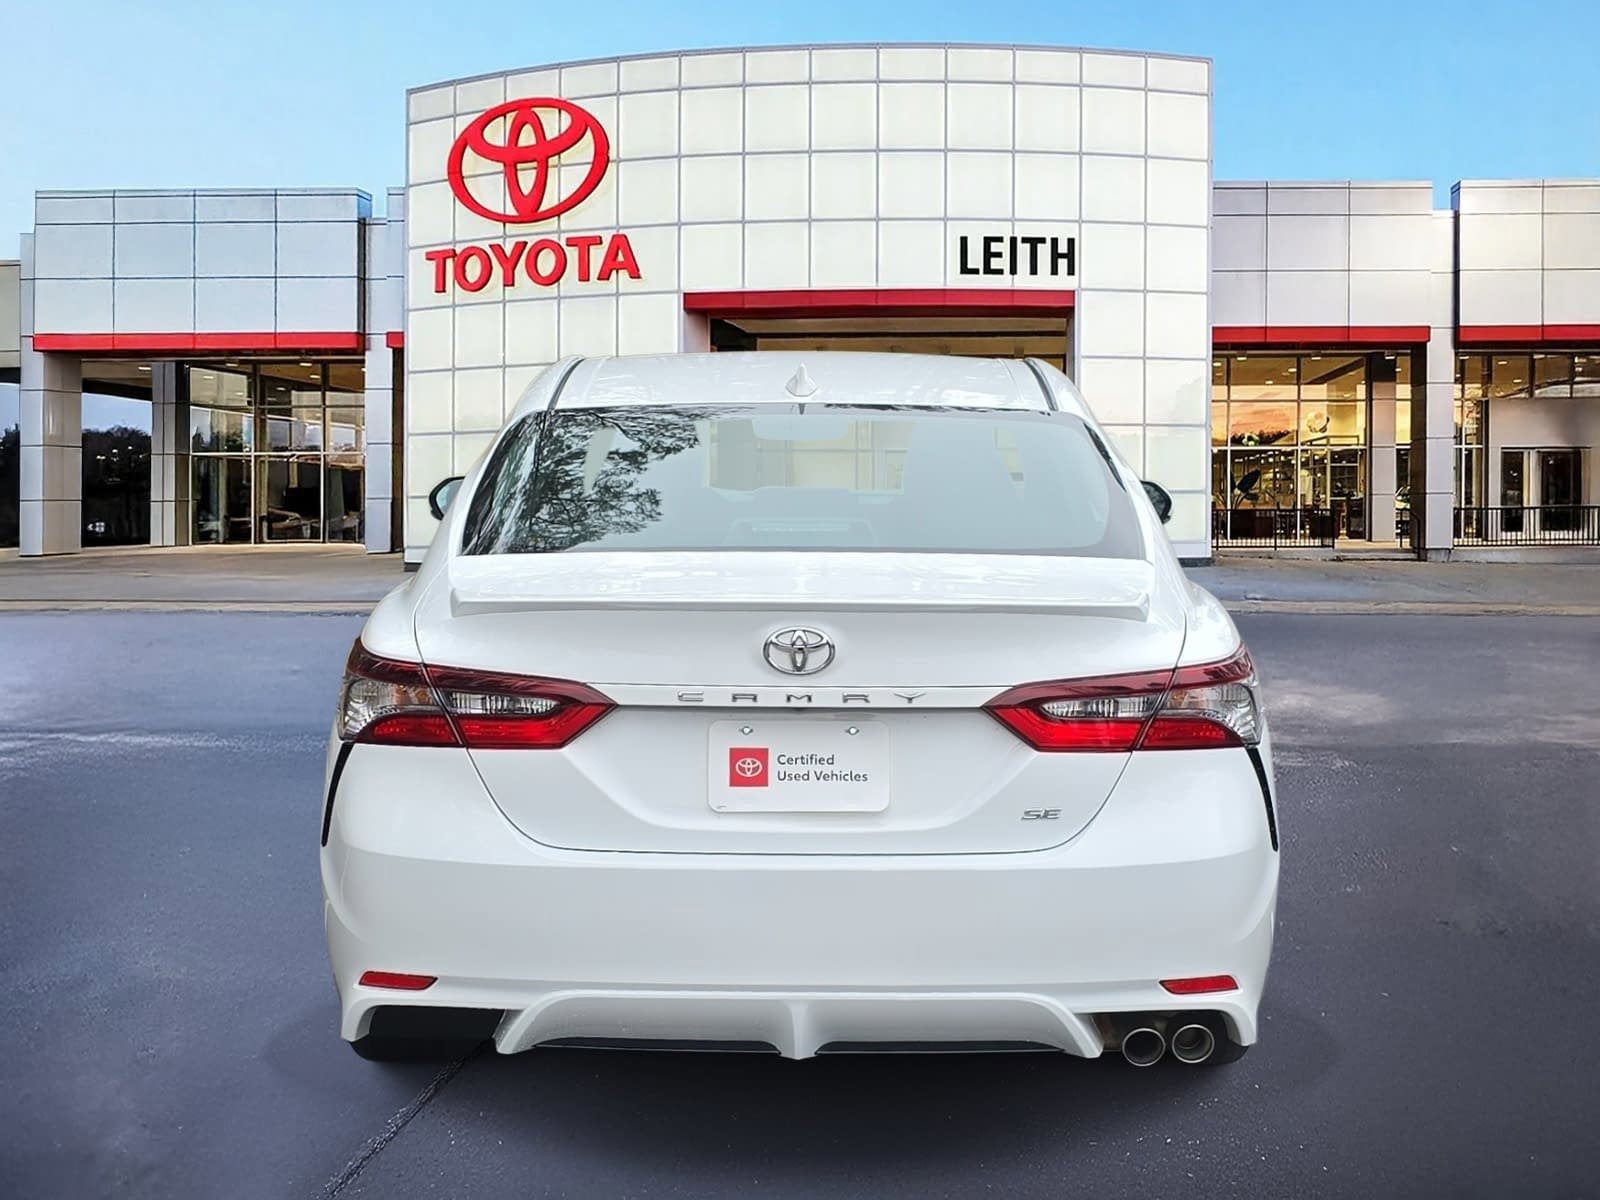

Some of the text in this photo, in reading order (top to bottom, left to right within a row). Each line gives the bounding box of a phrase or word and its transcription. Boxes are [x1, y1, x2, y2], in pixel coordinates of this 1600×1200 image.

[959, 236, 1076, 276] LEITH
[425, 233, 641, 294] TOYOTA
[677, 691, 926, 704] CAMRY
[777, 753, 835, 766] Certified
[777, 770, 868, 782] Used Vehicles
[1021, 807, 1062, 821] SE
